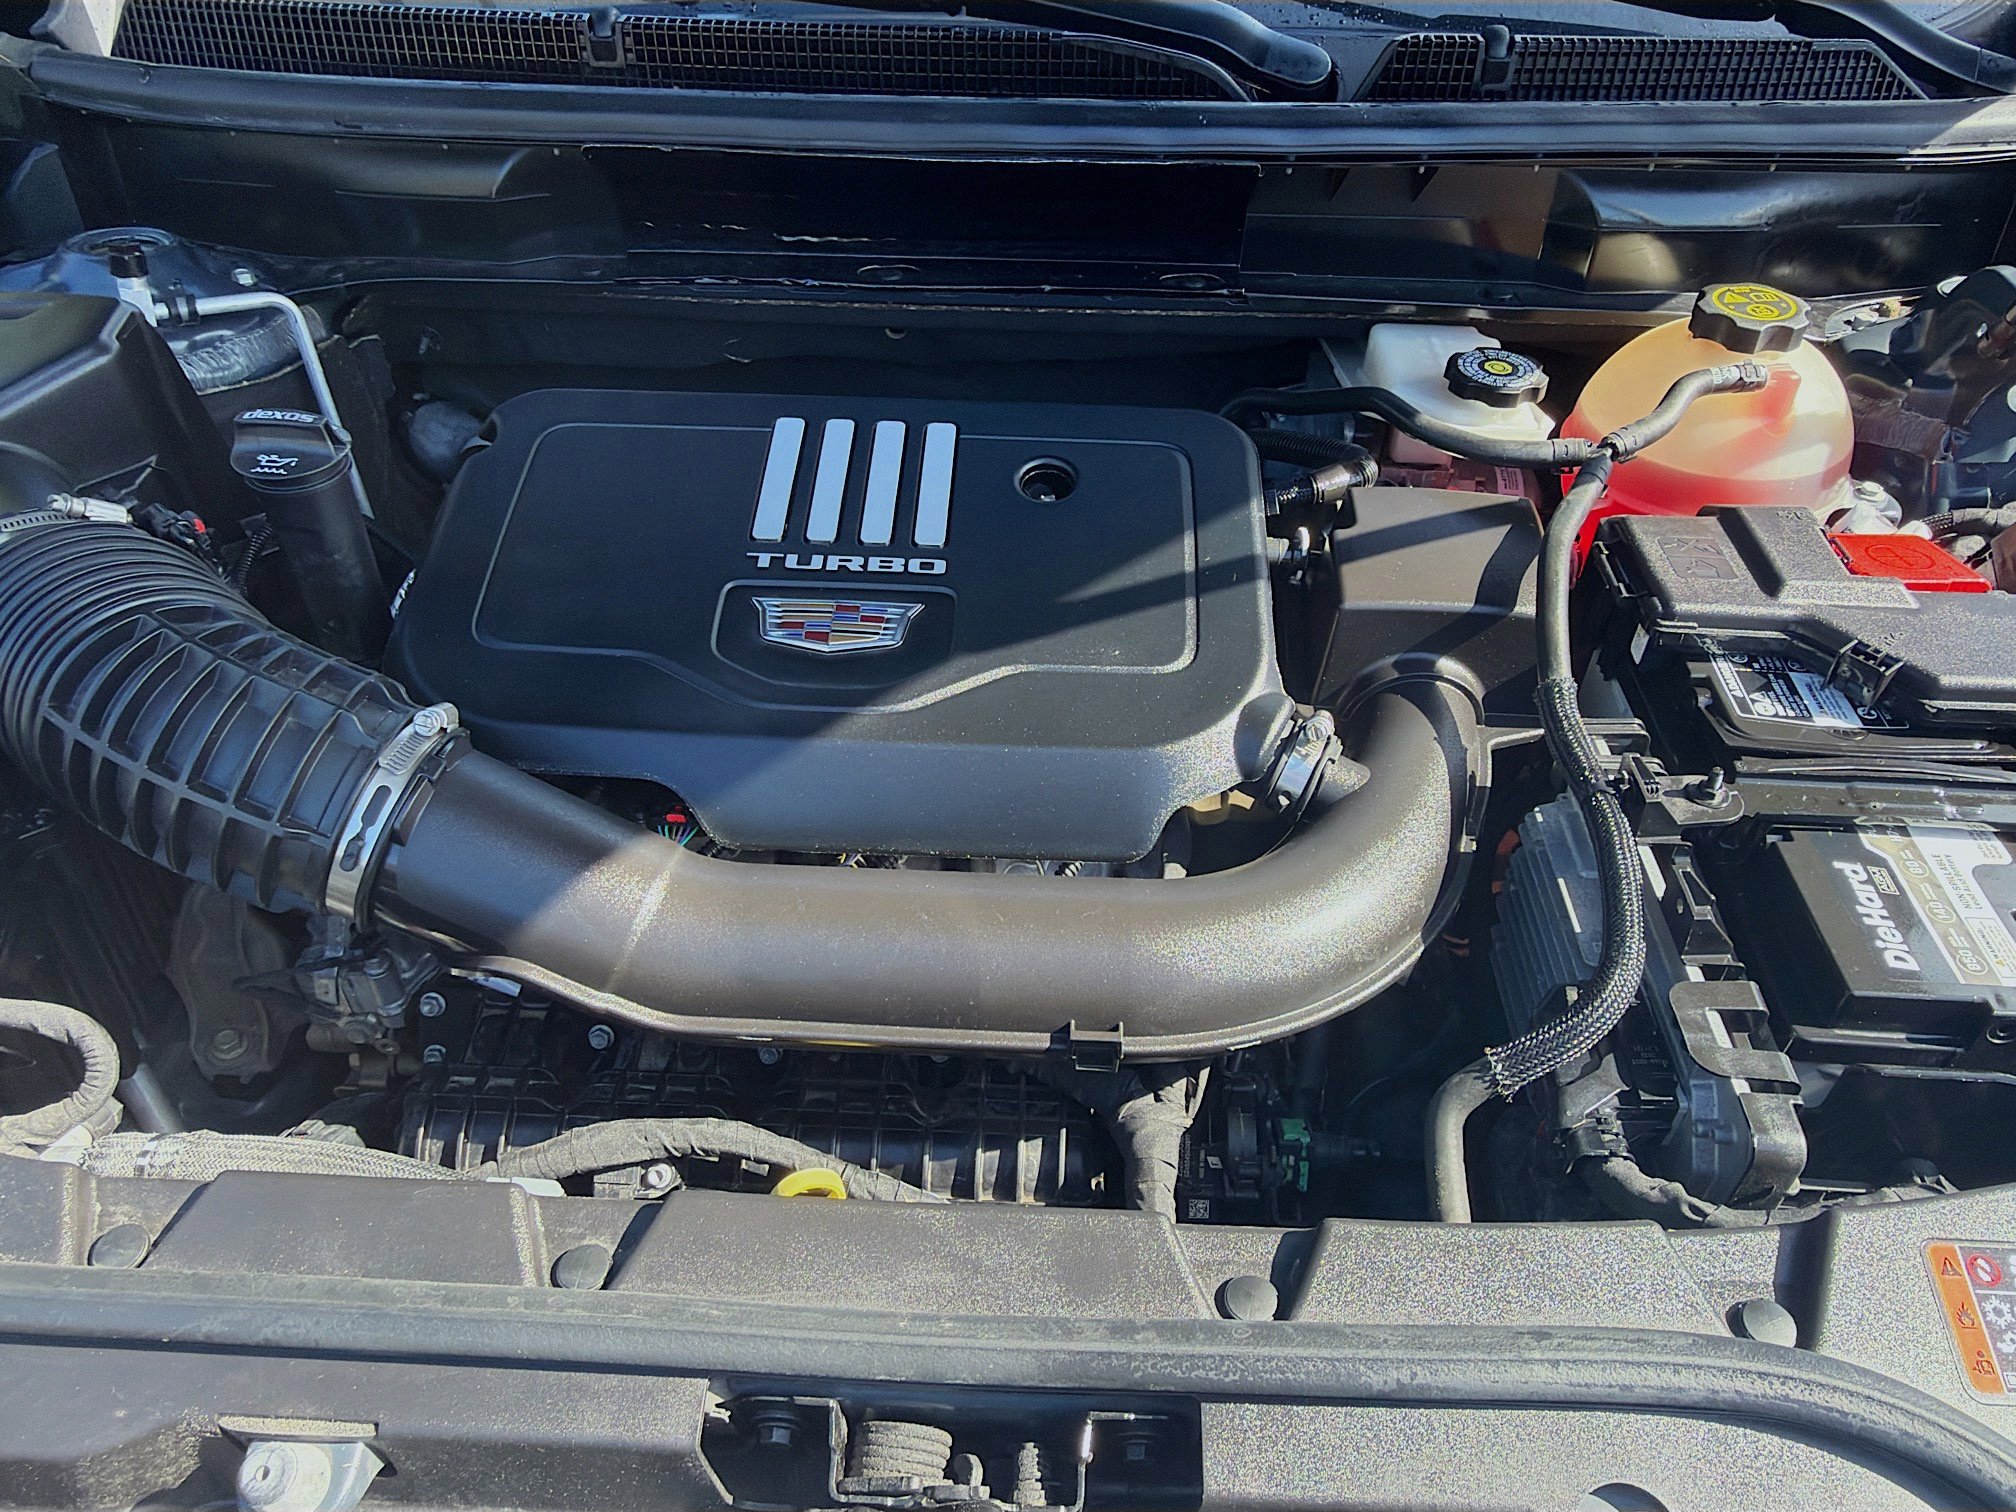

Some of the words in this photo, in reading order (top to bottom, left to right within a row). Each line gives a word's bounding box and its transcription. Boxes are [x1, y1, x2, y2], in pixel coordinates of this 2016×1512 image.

[243, 408, 318, 423] dexos
[747, 553, 947, 575] TURBO
[1904, 860, 1924, 872] 80
[1870, 868, 1892, 891] AGM
[1931, 853, 1973, 909] NON-SPILLABLE
[1832, 861, 1921, 970] DieHard
[1928, 901, 1951, 919] 140
[1958, 949, 1982, 970] 850
